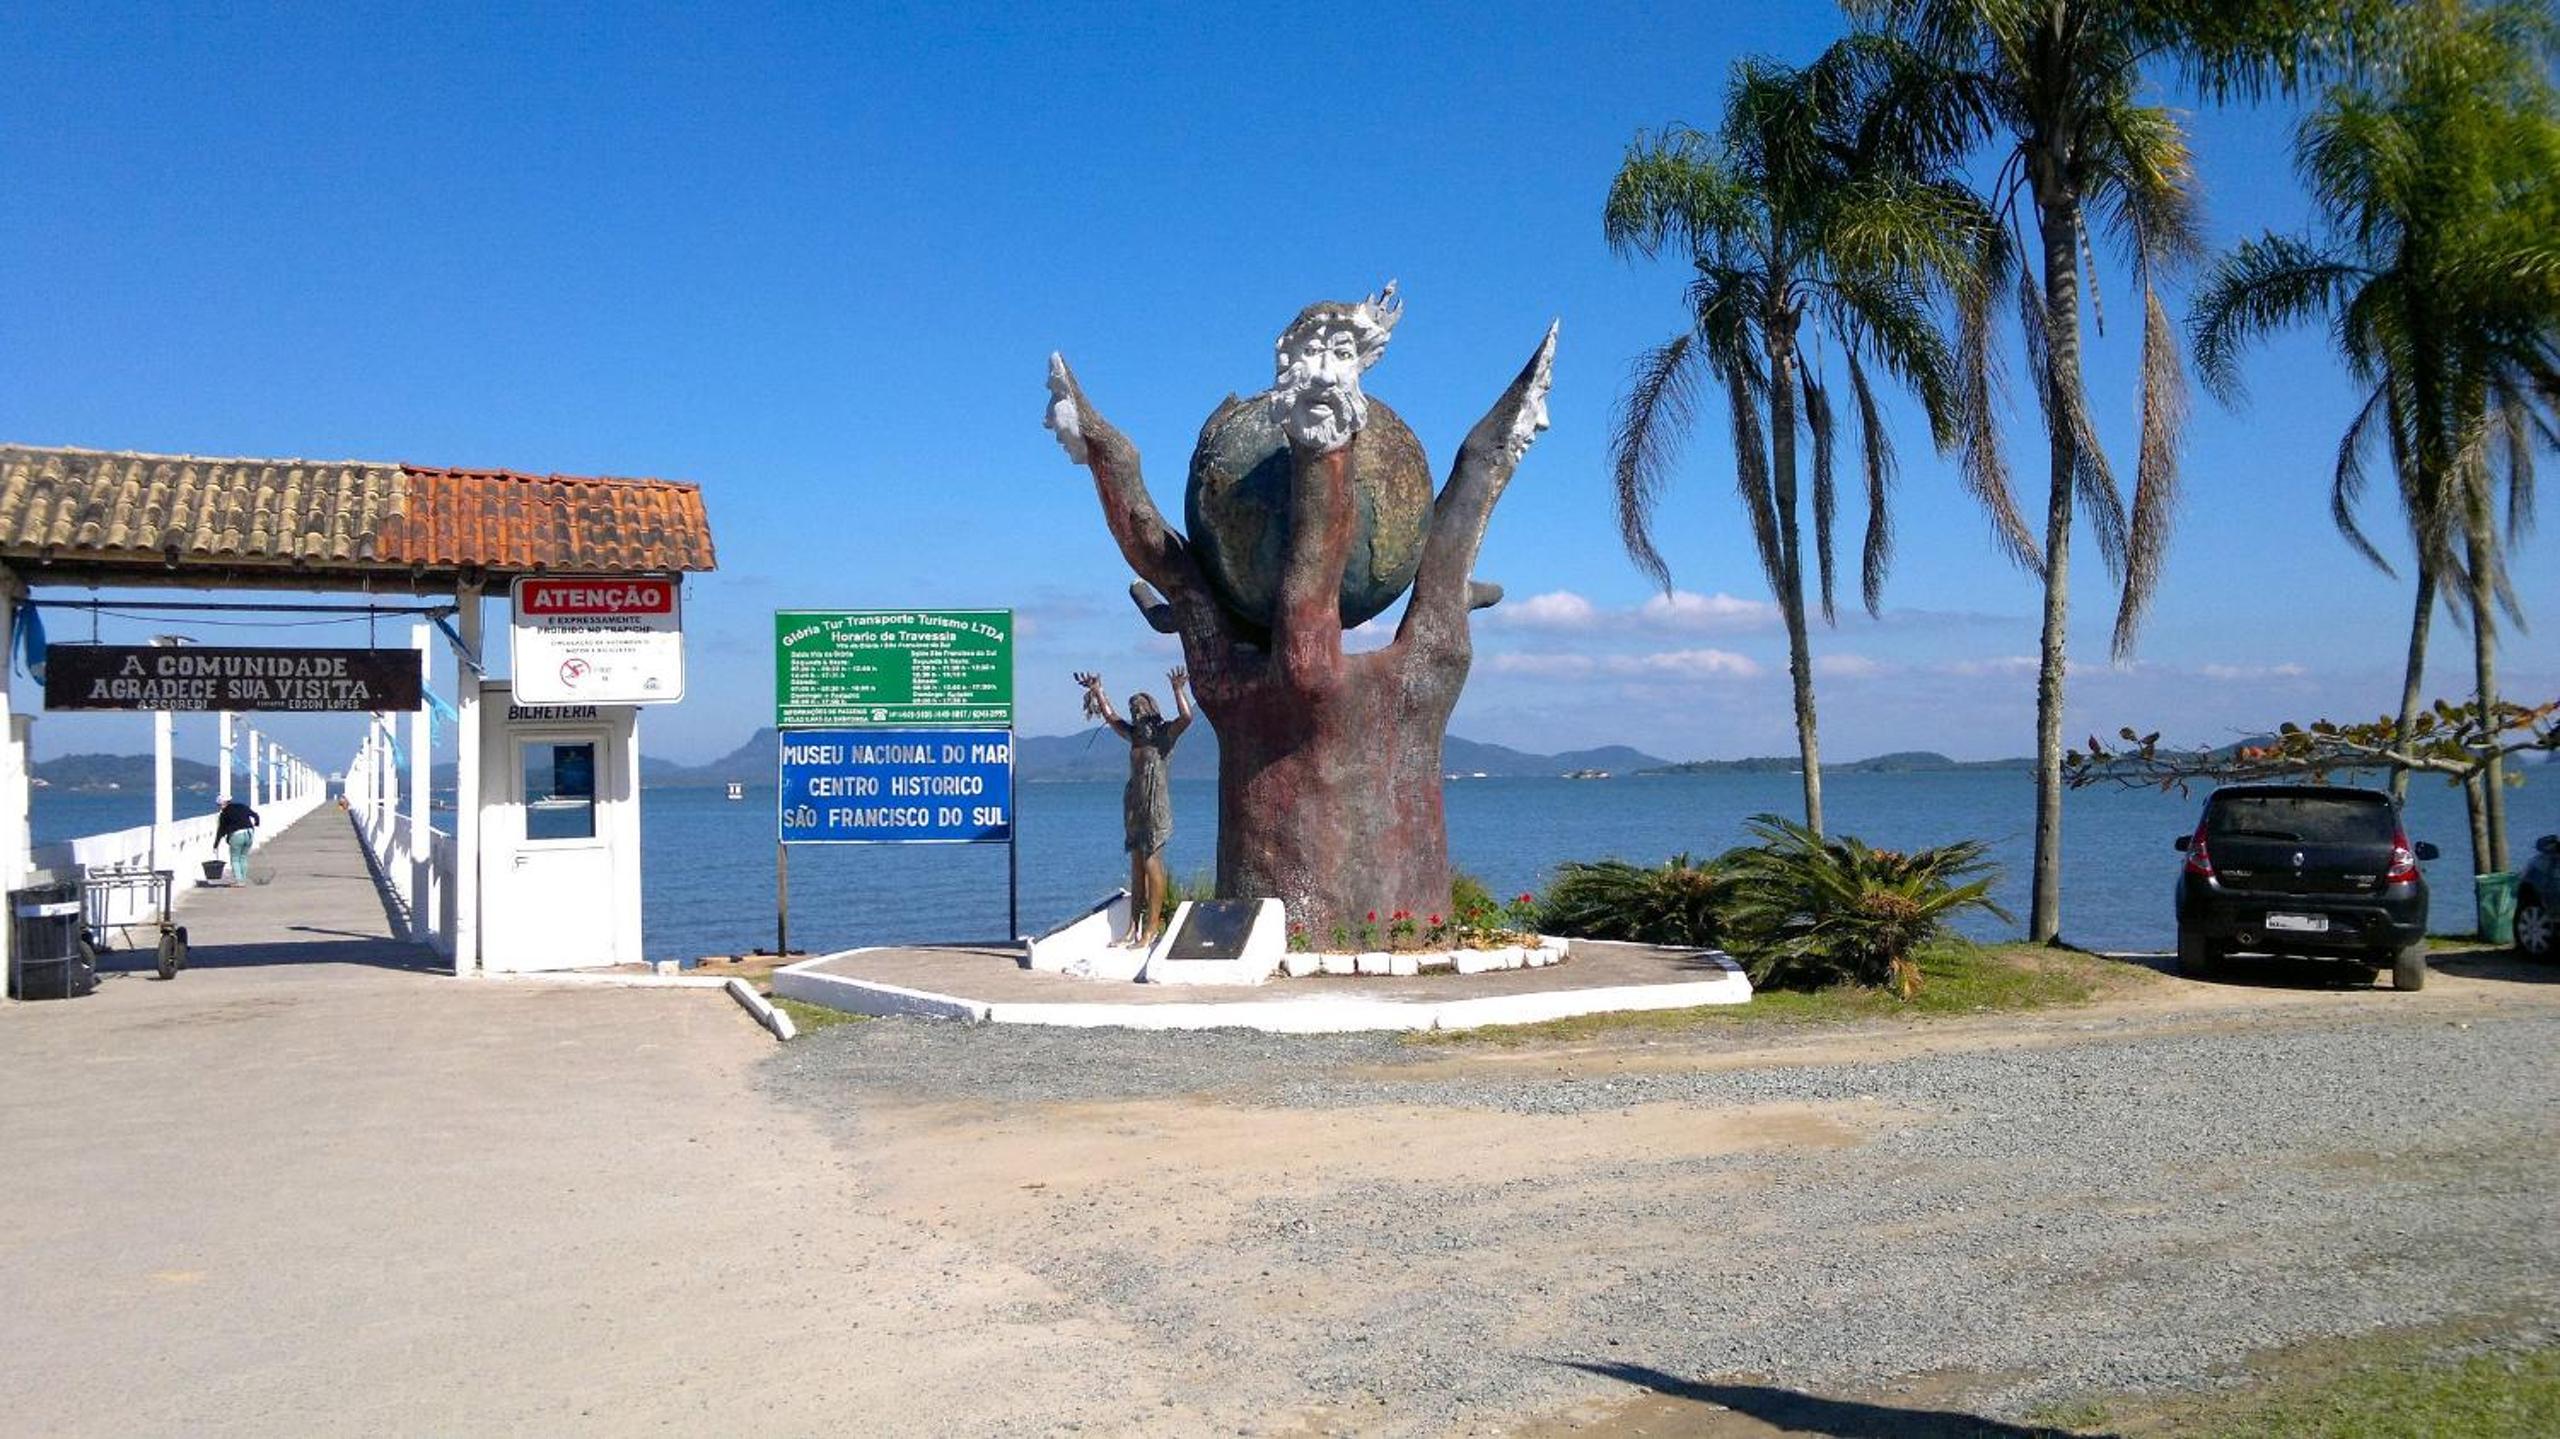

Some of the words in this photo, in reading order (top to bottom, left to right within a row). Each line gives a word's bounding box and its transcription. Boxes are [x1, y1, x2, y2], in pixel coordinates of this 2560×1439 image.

[534, 585, 661, 611] ATENÇÃO
[536, 626, 584, 634] PROIBIDO
[557, 616, 642, 624] EXPRESSAMENTE
[822, 620, 843, 630] Tur
[845, 614, 914, 626] Transporte
[918, 614, 968, 630] Turismo
[971, 621, 1004, 643] LTDA
[880, 631, 895, 641] de
[898, 631, 957, 641] Travessia
[119, 655, 146, 675] A
[157, 655, 347, 677] COMUNIDADE
[87, 679, 217, 699] AGRADECE
[228, 679, 270, 699] SUA
[508, 705, 597, 720] BILHETERIA
[782, 745, 844, 765] MUSEU
[852, 745, 936, 764] NACIONAL
[942, 745, 965, 764] DO
[971, 744, 1009, 764] MAR
[809, 776, 879, 796] CENTRO
[892, 776, 983, 795] HISTORICO
[783, 805, 817, 827] SÃO
[828, 807, 929, 827] FRANCISCO
[938, 807, 962, 826] DO
[973, 807, 1008, 826] SUL
